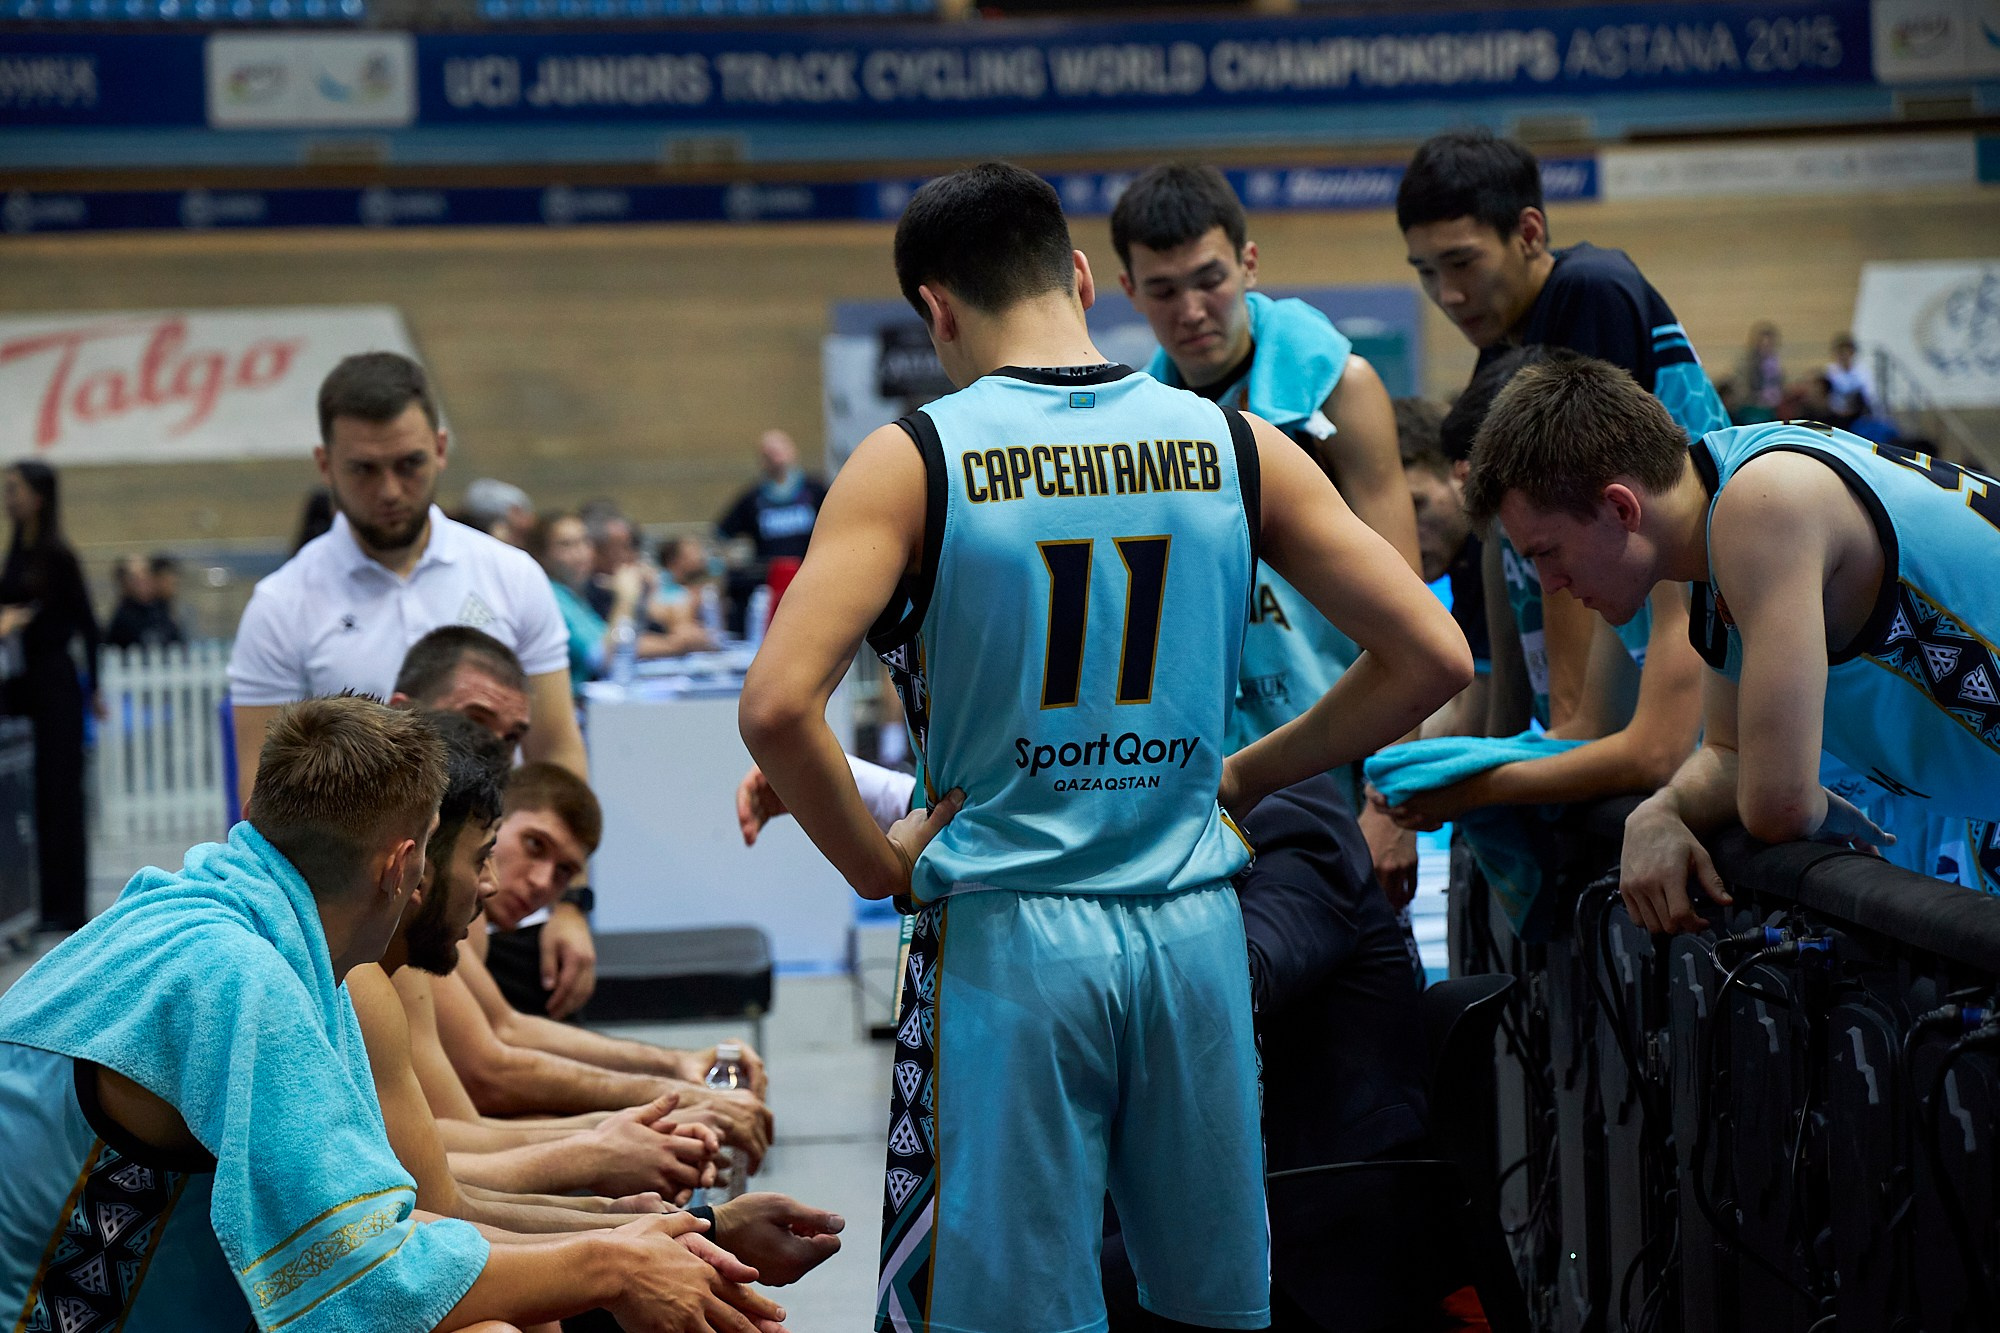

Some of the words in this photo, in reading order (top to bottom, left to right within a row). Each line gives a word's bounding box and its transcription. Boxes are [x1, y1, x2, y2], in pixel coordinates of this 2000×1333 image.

[446, 57, 519, 105] UCI
[527, 53, 711, 106] JUNIORS
[714, 51, 860, 103] TRACK
[862, 47, 1048, 100] CYCLING
[1049, 41, 1207, 96] WORLD
[1212, 31, 1558, 90] CHAMPIONSHIPS
[1564, 23, 1740, 79] ASTANA
[1745, 15, 1843, 71] 2015
[0, 316, 304, 447] Talgo
[962, 439, 1222, 505] САРСЕНГАЛИЕВ
[1035, 534, 1172, 710] 11
[1015, 732, 1200, 777] SportQory
[1054, 775, 1160, 792] QAZAQSTAN
